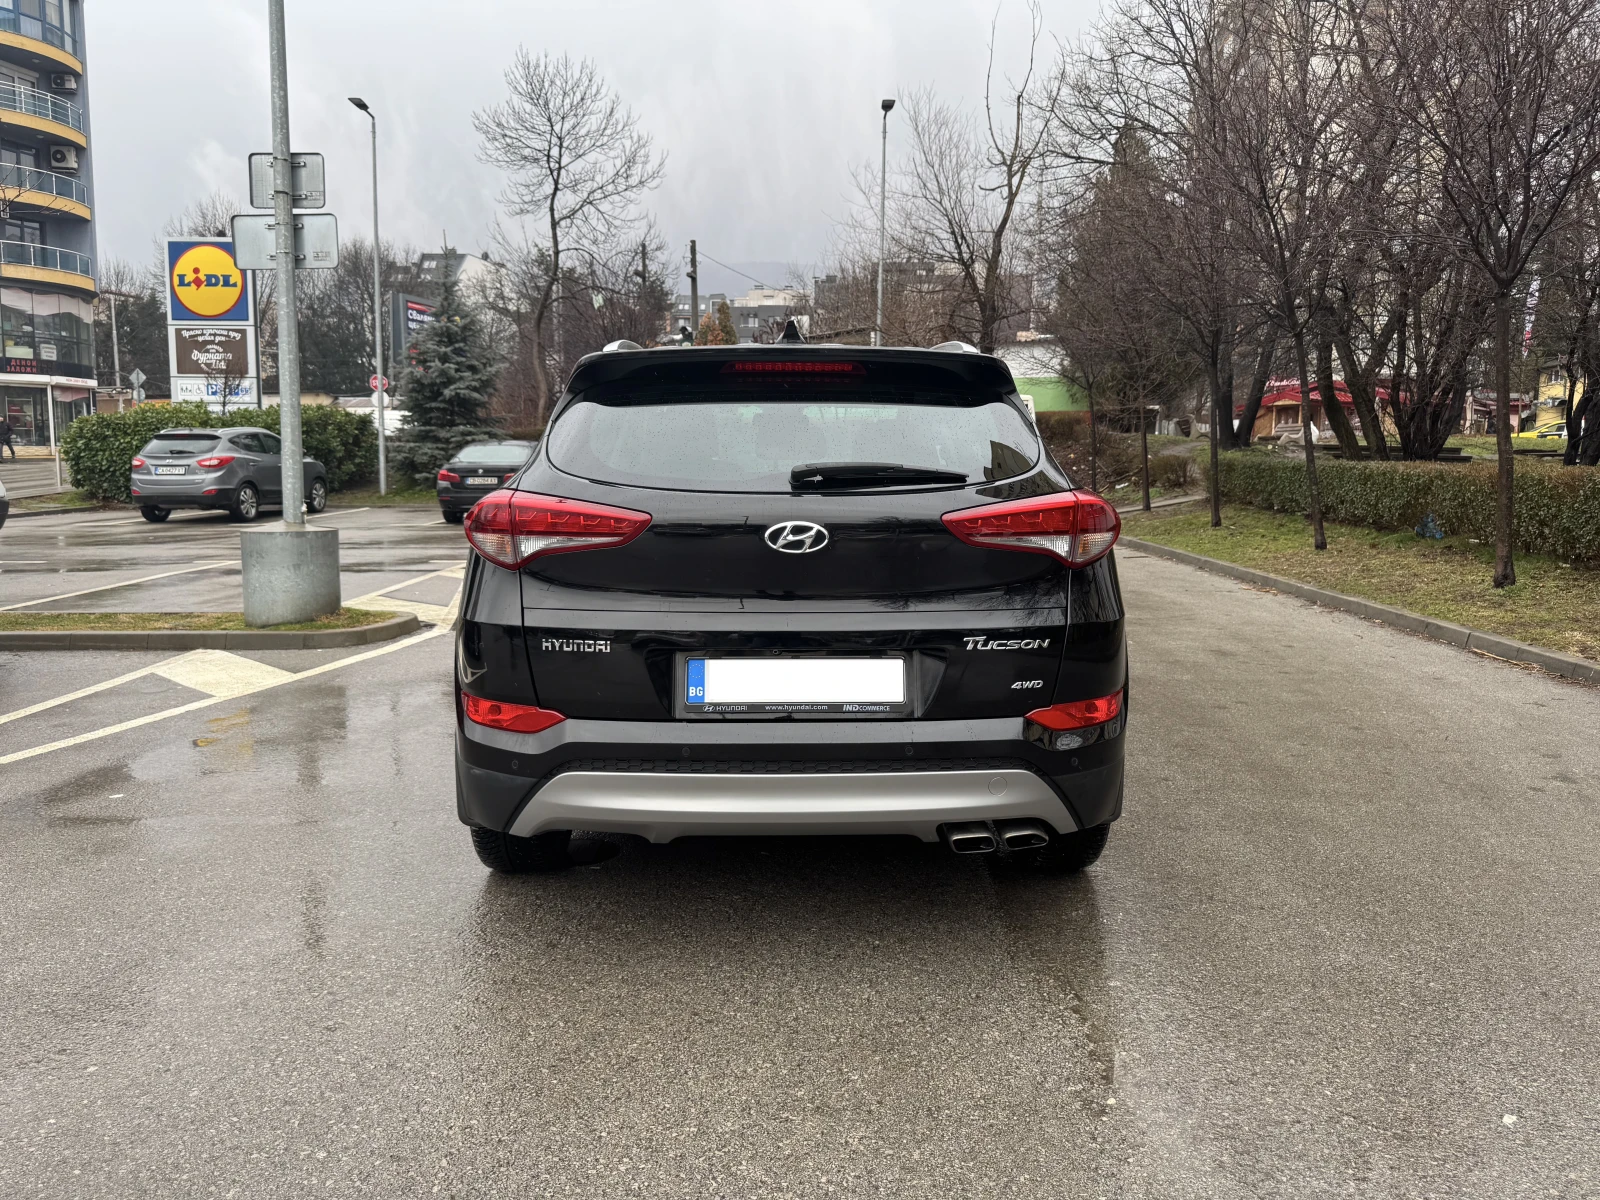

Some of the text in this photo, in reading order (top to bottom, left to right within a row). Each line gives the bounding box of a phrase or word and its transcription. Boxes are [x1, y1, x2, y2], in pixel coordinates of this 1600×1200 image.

[191, 349, 232, 363] Фурната
[542, 638, 611, 653] HYUNDAI
[963, 635, 1051, 651] TUCSON
[689, 686, 704, 697] BG
[1010, 679, 1044, 690] 4WD
